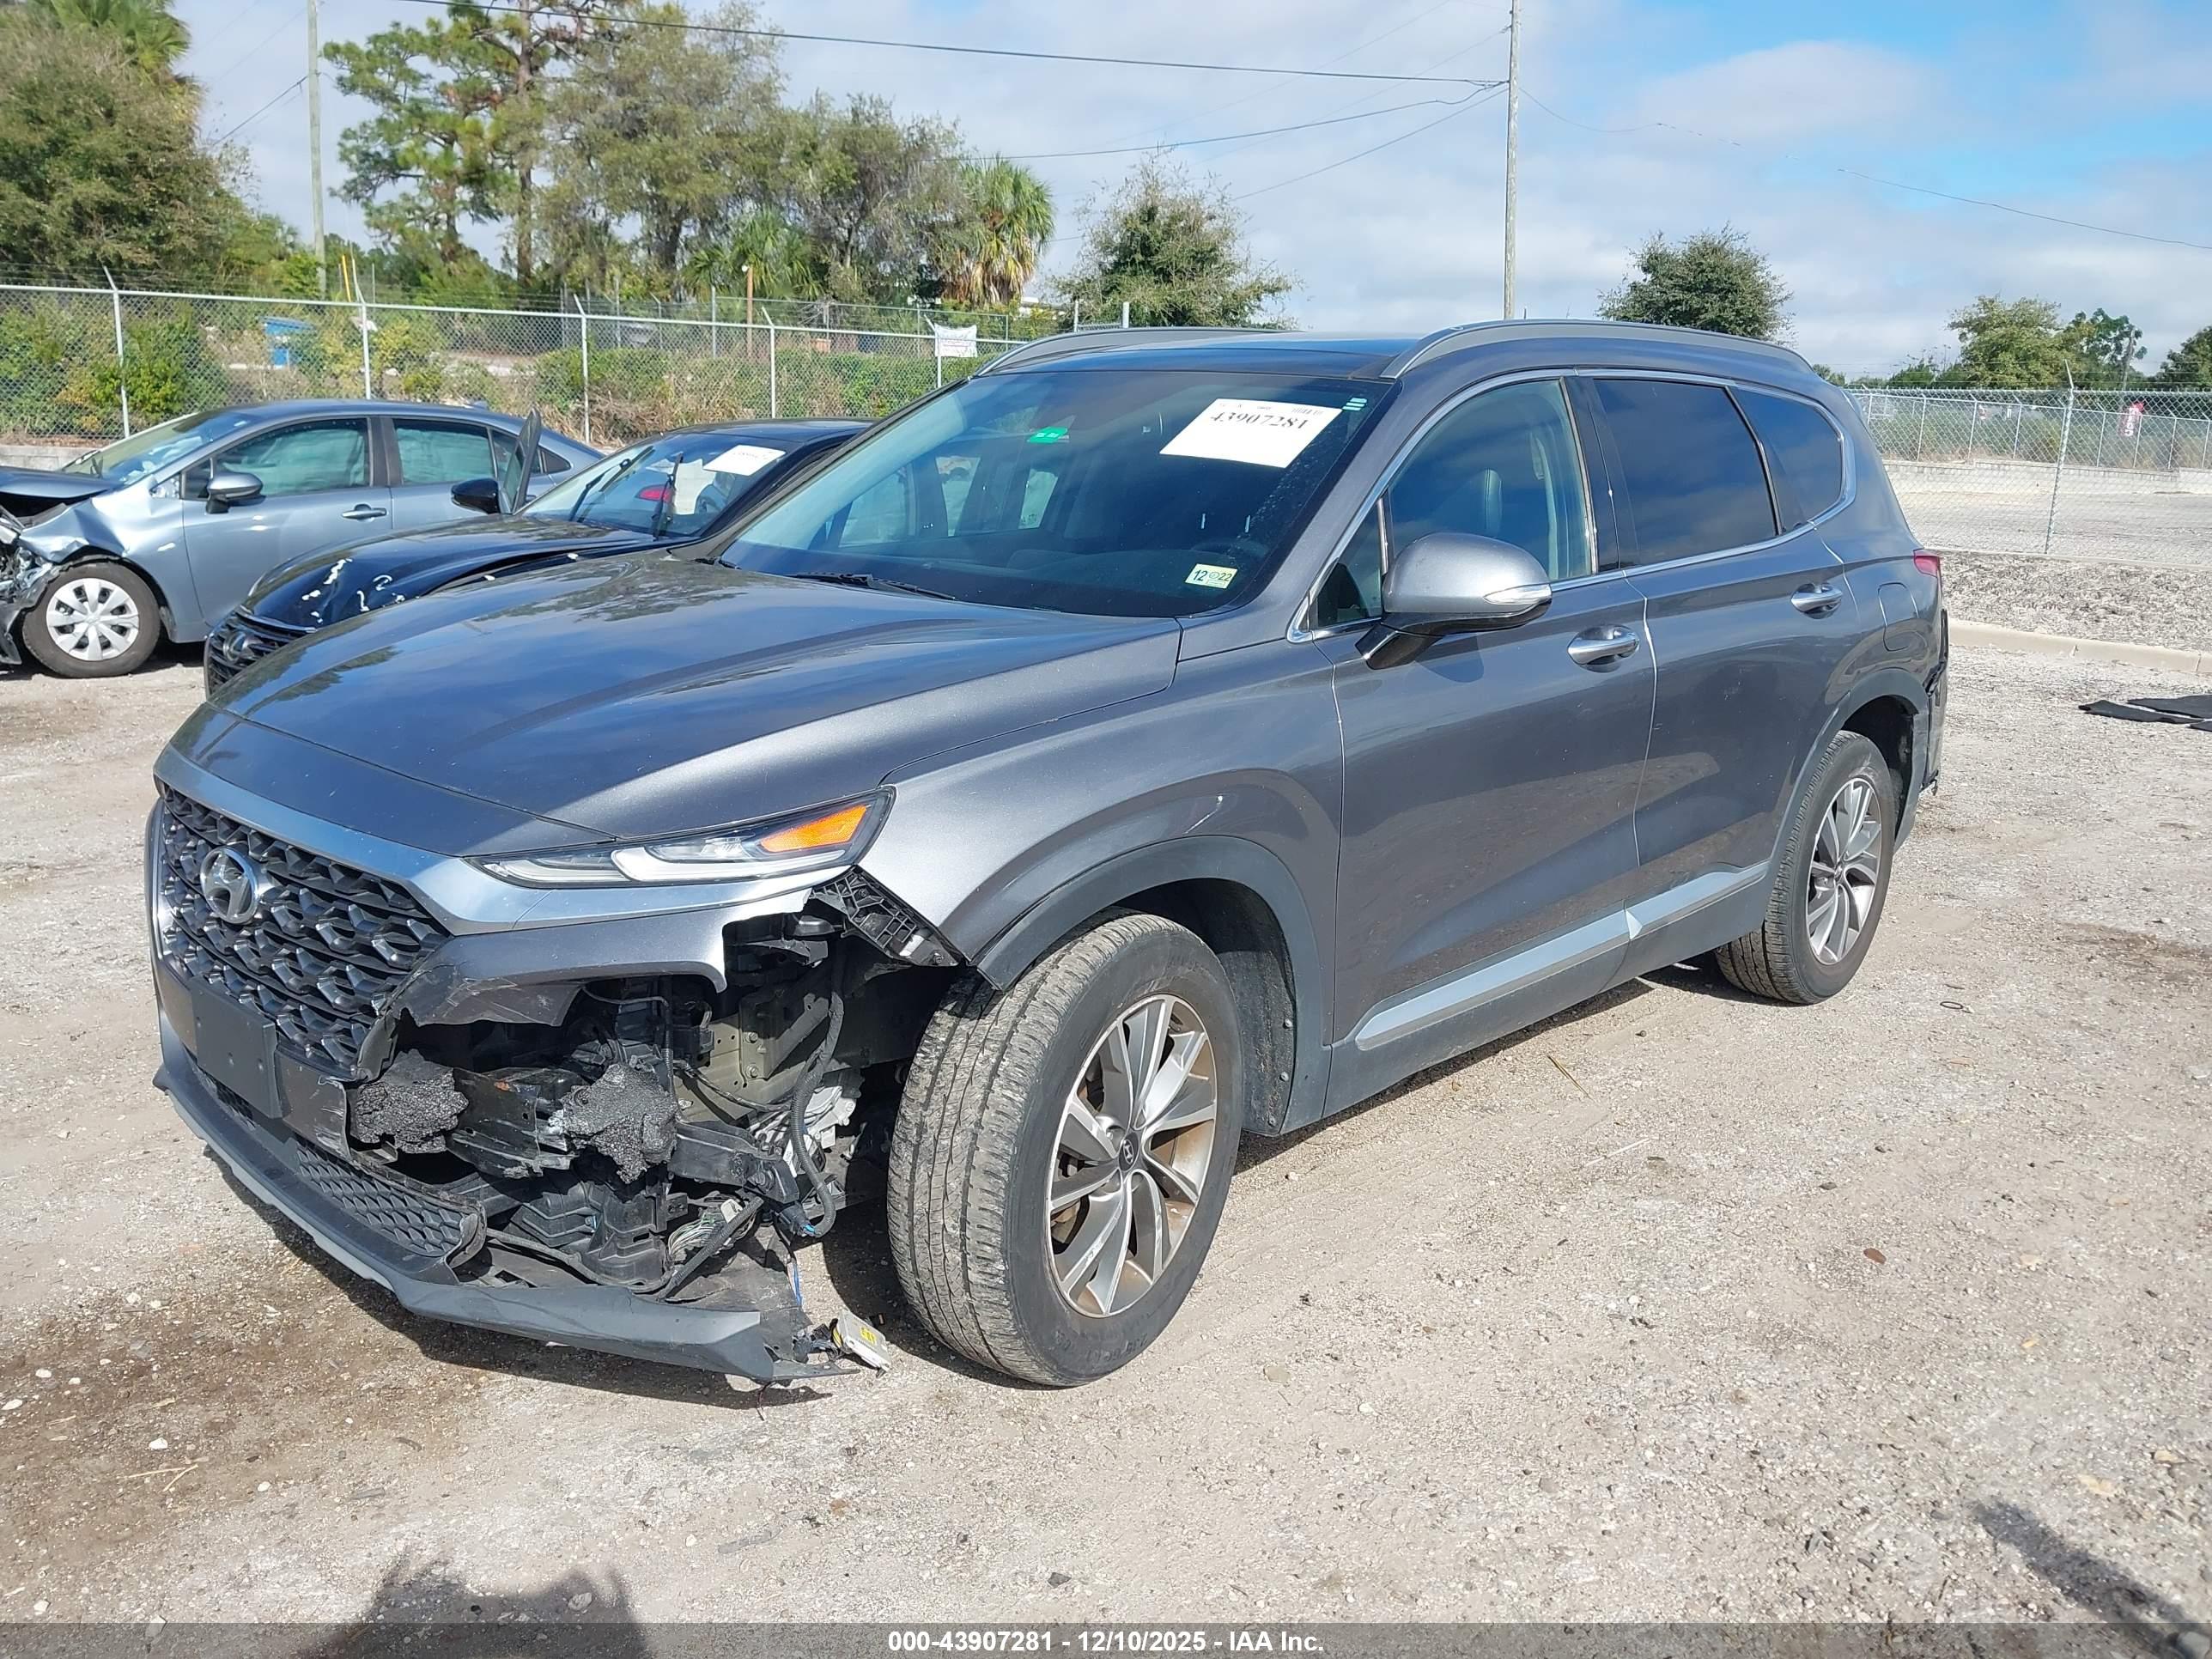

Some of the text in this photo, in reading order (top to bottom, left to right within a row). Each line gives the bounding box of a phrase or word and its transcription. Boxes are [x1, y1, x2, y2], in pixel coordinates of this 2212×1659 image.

[1211, 411, 1309, 429] 43907281
[1193, 569, 1233, 582] 12 22
